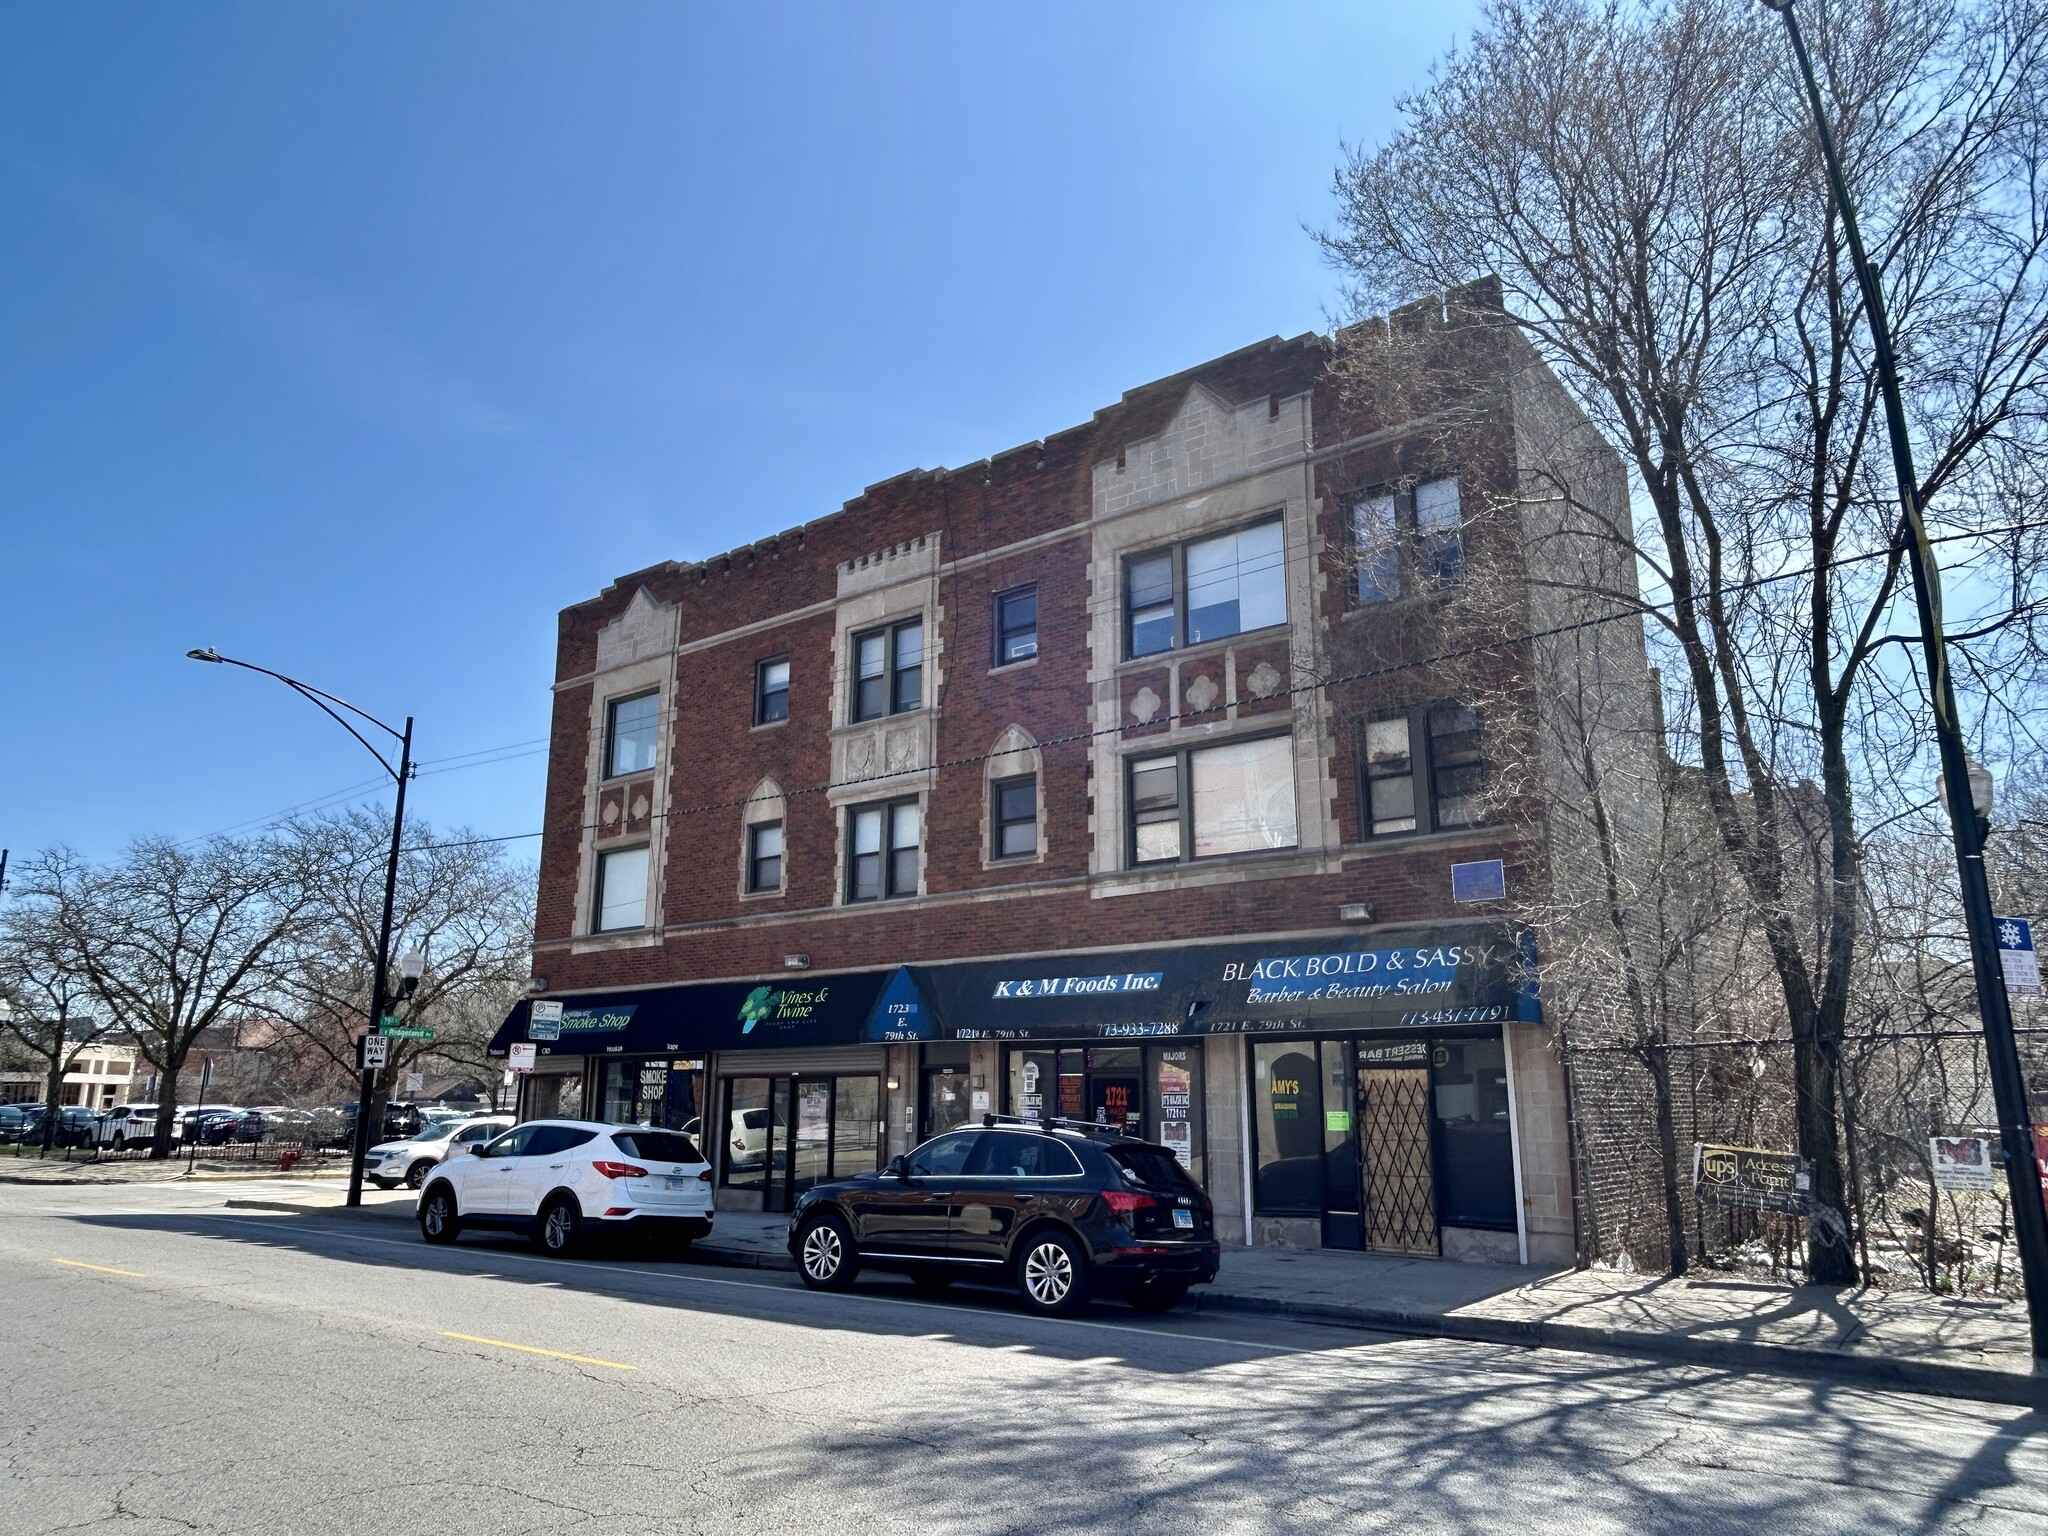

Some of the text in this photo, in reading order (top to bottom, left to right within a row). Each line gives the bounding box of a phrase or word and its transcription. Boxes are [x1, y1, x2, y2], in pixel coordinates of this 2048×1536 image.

[1305, 953, 1377, 976] BOLD
[1386, 951, 1405, 970] &
[1414, 945, 1495, 968] SASSY
[994, 974, 1159, 997] K & M Foods Inc.
[1246, 978, 1452, 1004] Barber & Beauty Salon
[781, 987, 829, 1005] Vines &
[776, 1004, 812, 1019] Twine
[888, 1004, 909, 1014] 1723
[560, 1016, 597, 1030] Smoke
[598, 1013, 631, 1031] Shop
[897, 1017, 908, 1027] E.
[1096, 1022, 1180, 1036] 773-933-7288
[1210, 1021, 1236, 1032] 1721
[1259, 1020, 1284, 1030] 79th
[389, 1028, 424, 1038] Ridgeland
[884, 1031, 919, 1041] 79th St.
[995, 1029, 1016, 1038] 79th
[367, 1037, 386, 1046] ONE
[367, 1047, 385, 1055] WAY
[1162, 1051, 1187, 1061] MAJORS
[640, 1069, 668, 1084] SMOKE
[642, 1085, 664, 1100] SHOP
[1271, 1080, 1299, 1095] AMY'S
[1105, 1086, 1128, 1106] 1721
[1705, 1159, 1735, 1178] ups
[1745, 1158, 1795, 1174] Access
